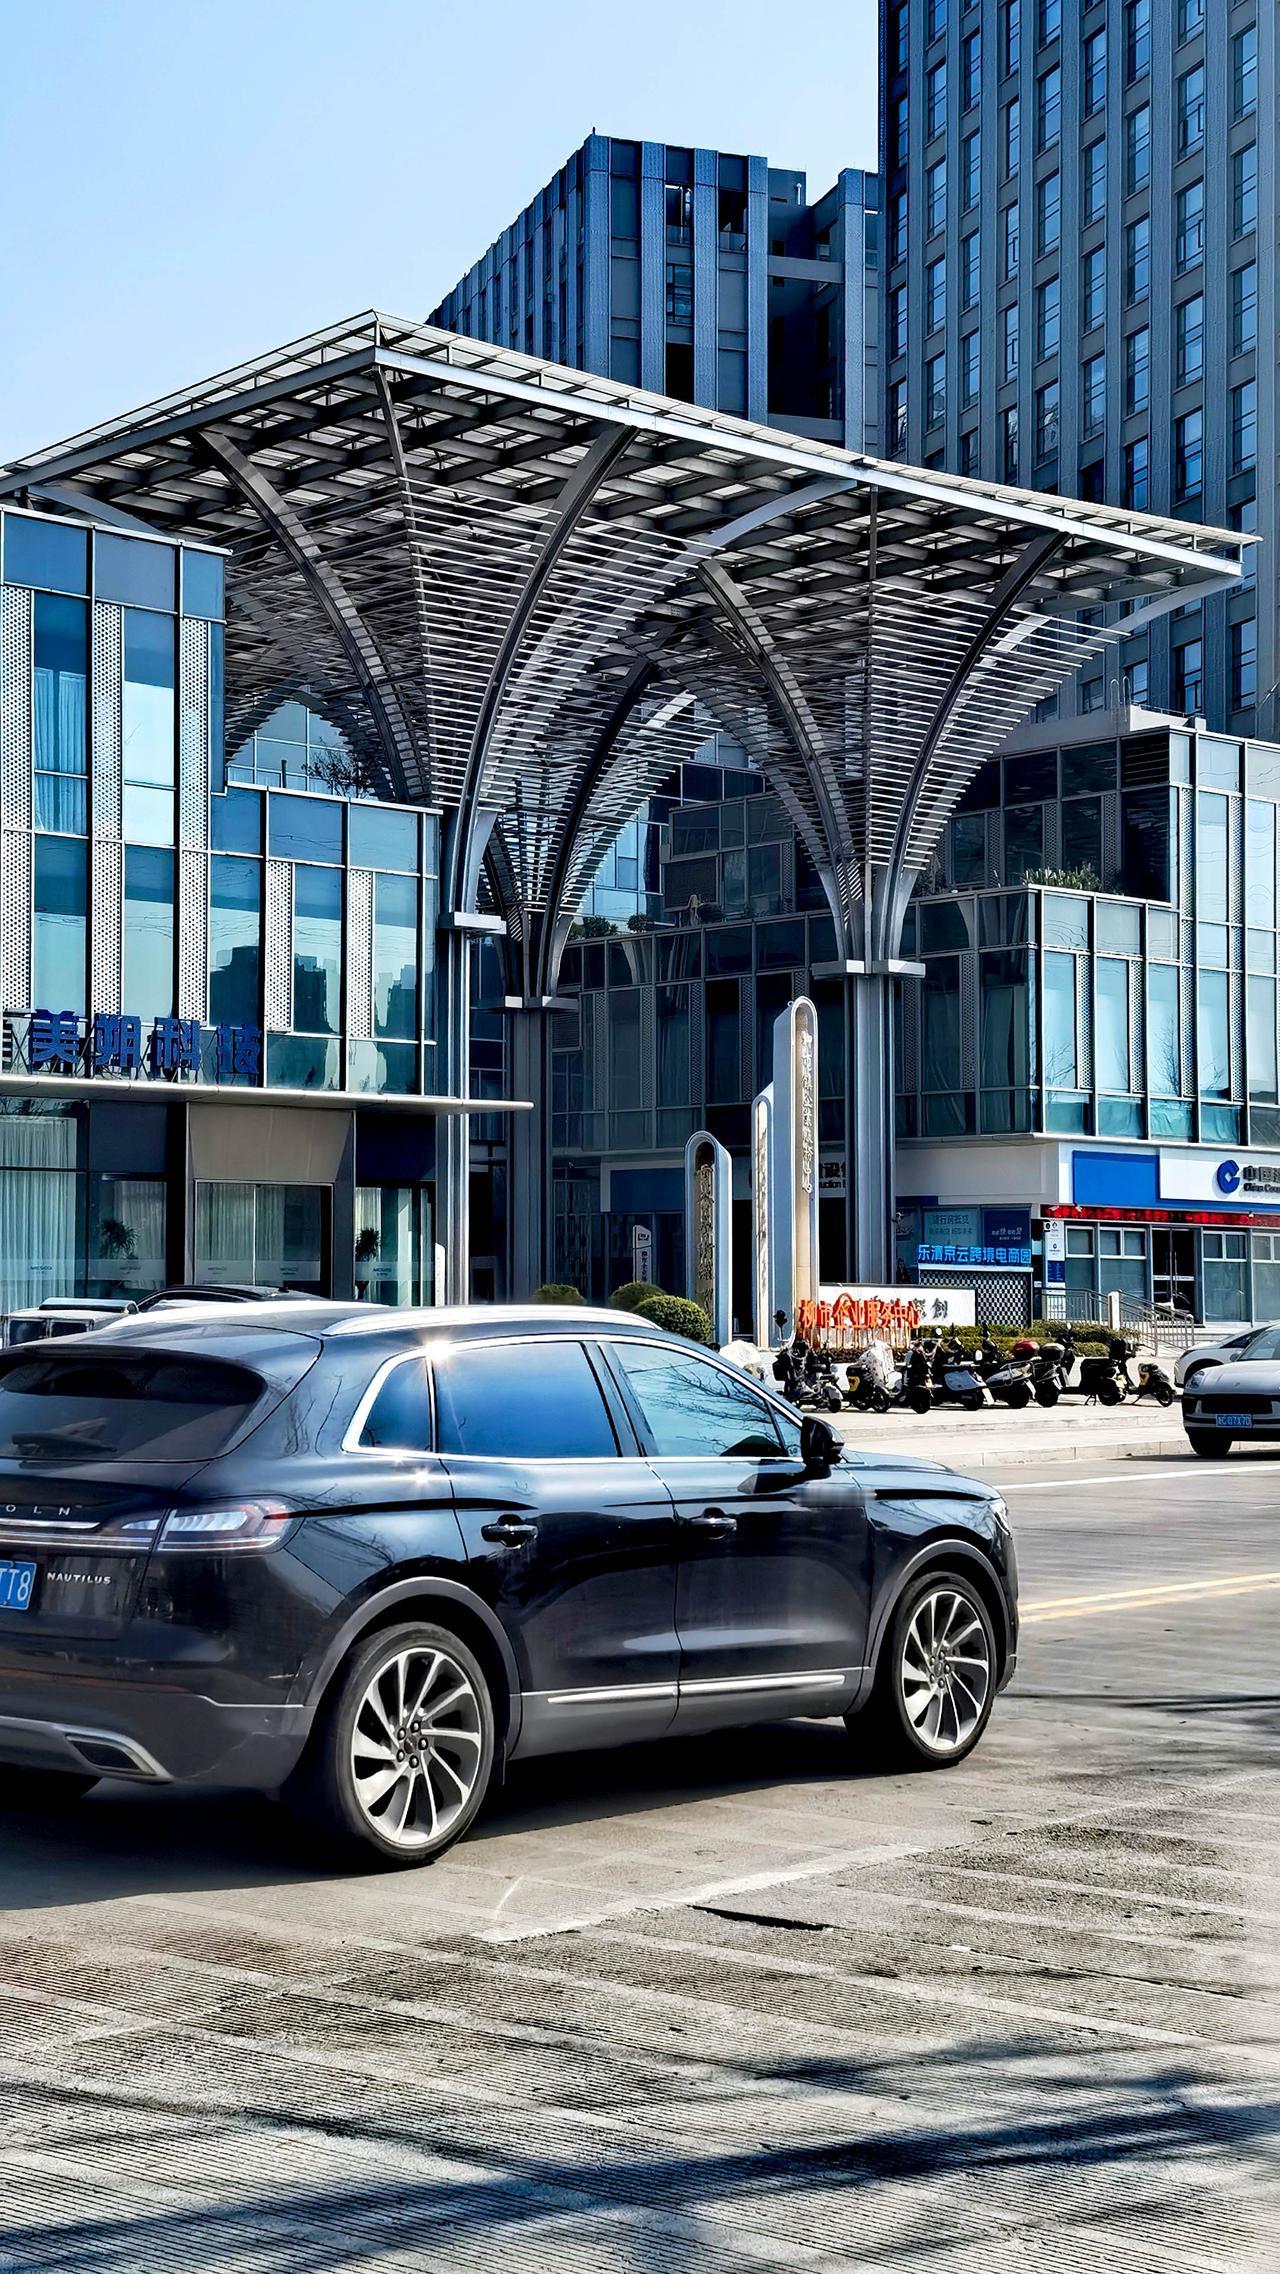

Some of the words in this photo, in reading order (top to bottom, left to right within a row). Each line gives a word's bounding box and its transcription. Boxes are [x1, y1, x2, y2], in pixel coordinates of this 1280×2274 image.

[2, 1009, 261, 1074] 美朔科技
[800, 1295, 922, 1328] 柳市企业服务中心
[47, 1572, 111, 1585] NAUTILUS
